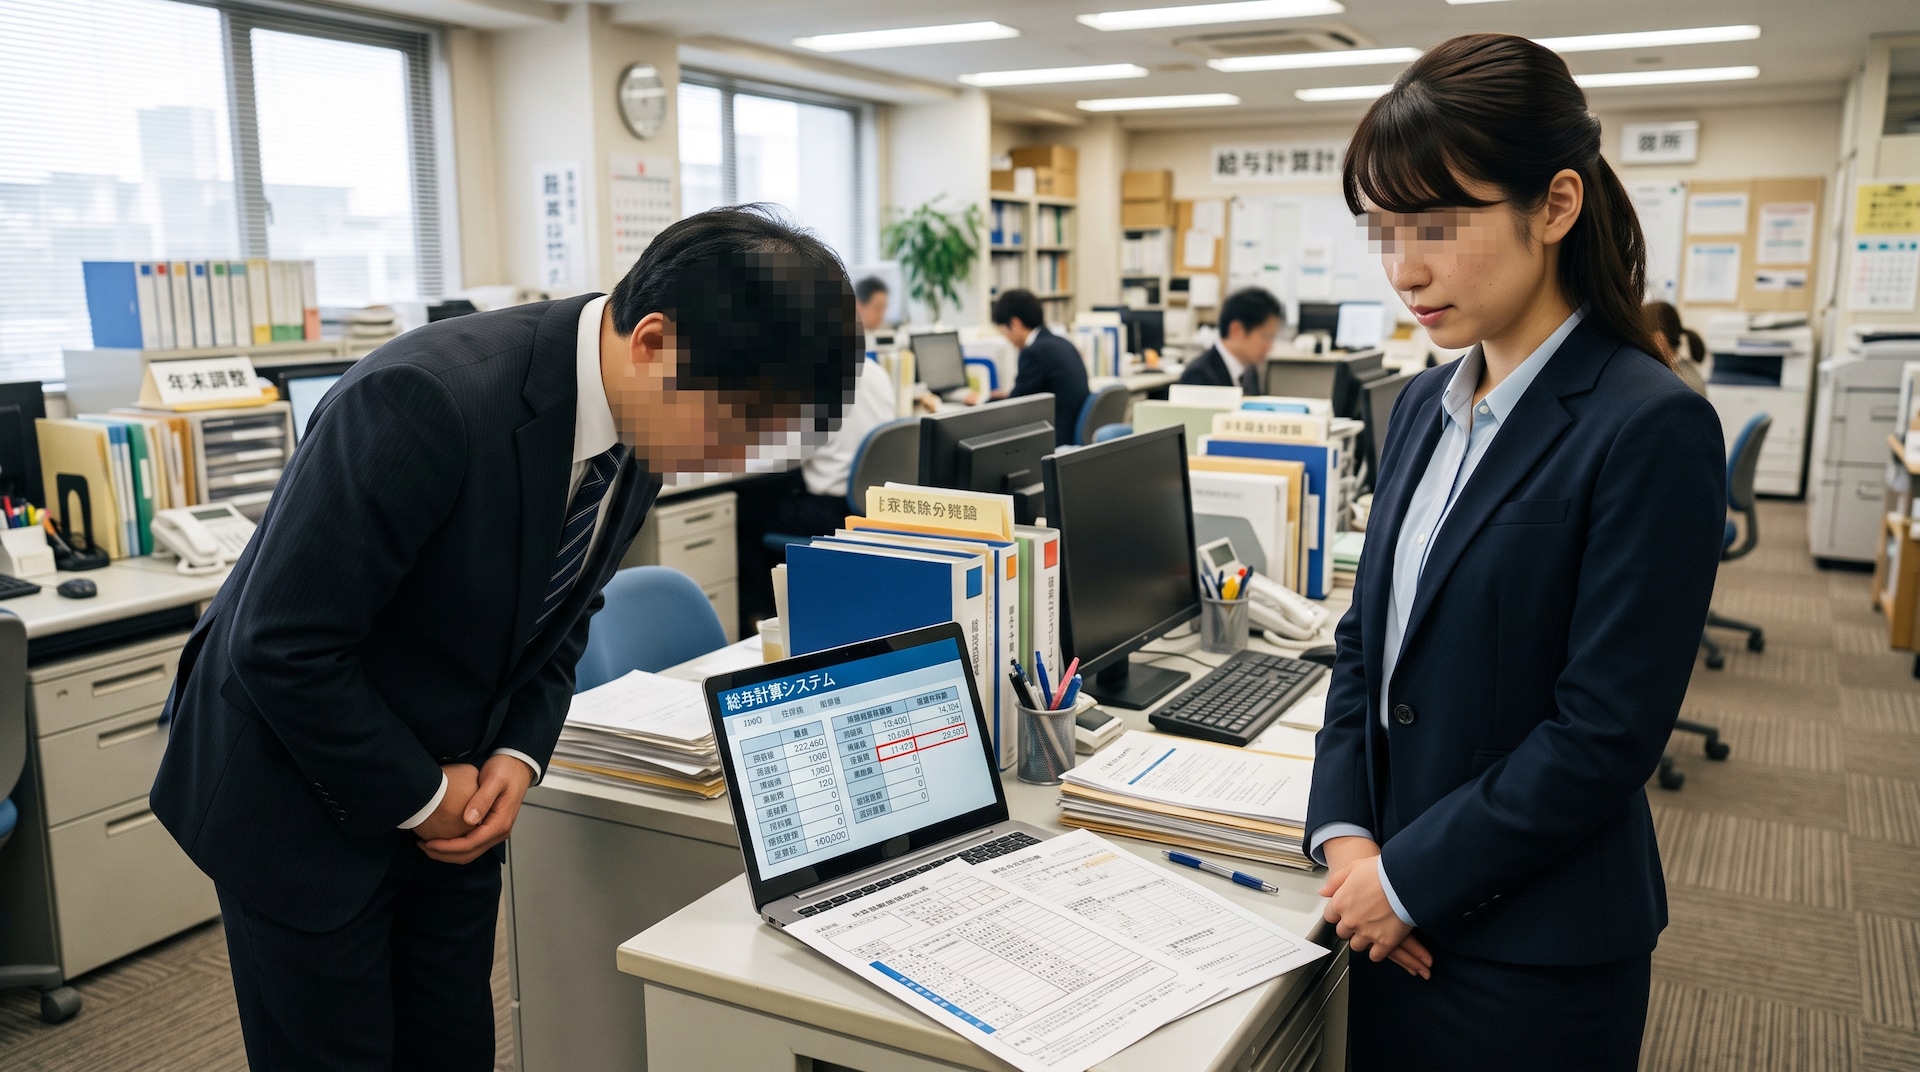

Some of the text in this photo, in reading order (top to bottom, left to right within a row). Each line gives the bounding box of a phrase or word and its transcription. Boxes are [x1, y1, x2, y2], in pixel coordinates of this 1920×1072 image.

[168, 370, 248, 392] 年末調整
[793, 738, 824, 753] 222,460
[818, 778, 834, 788] 120
